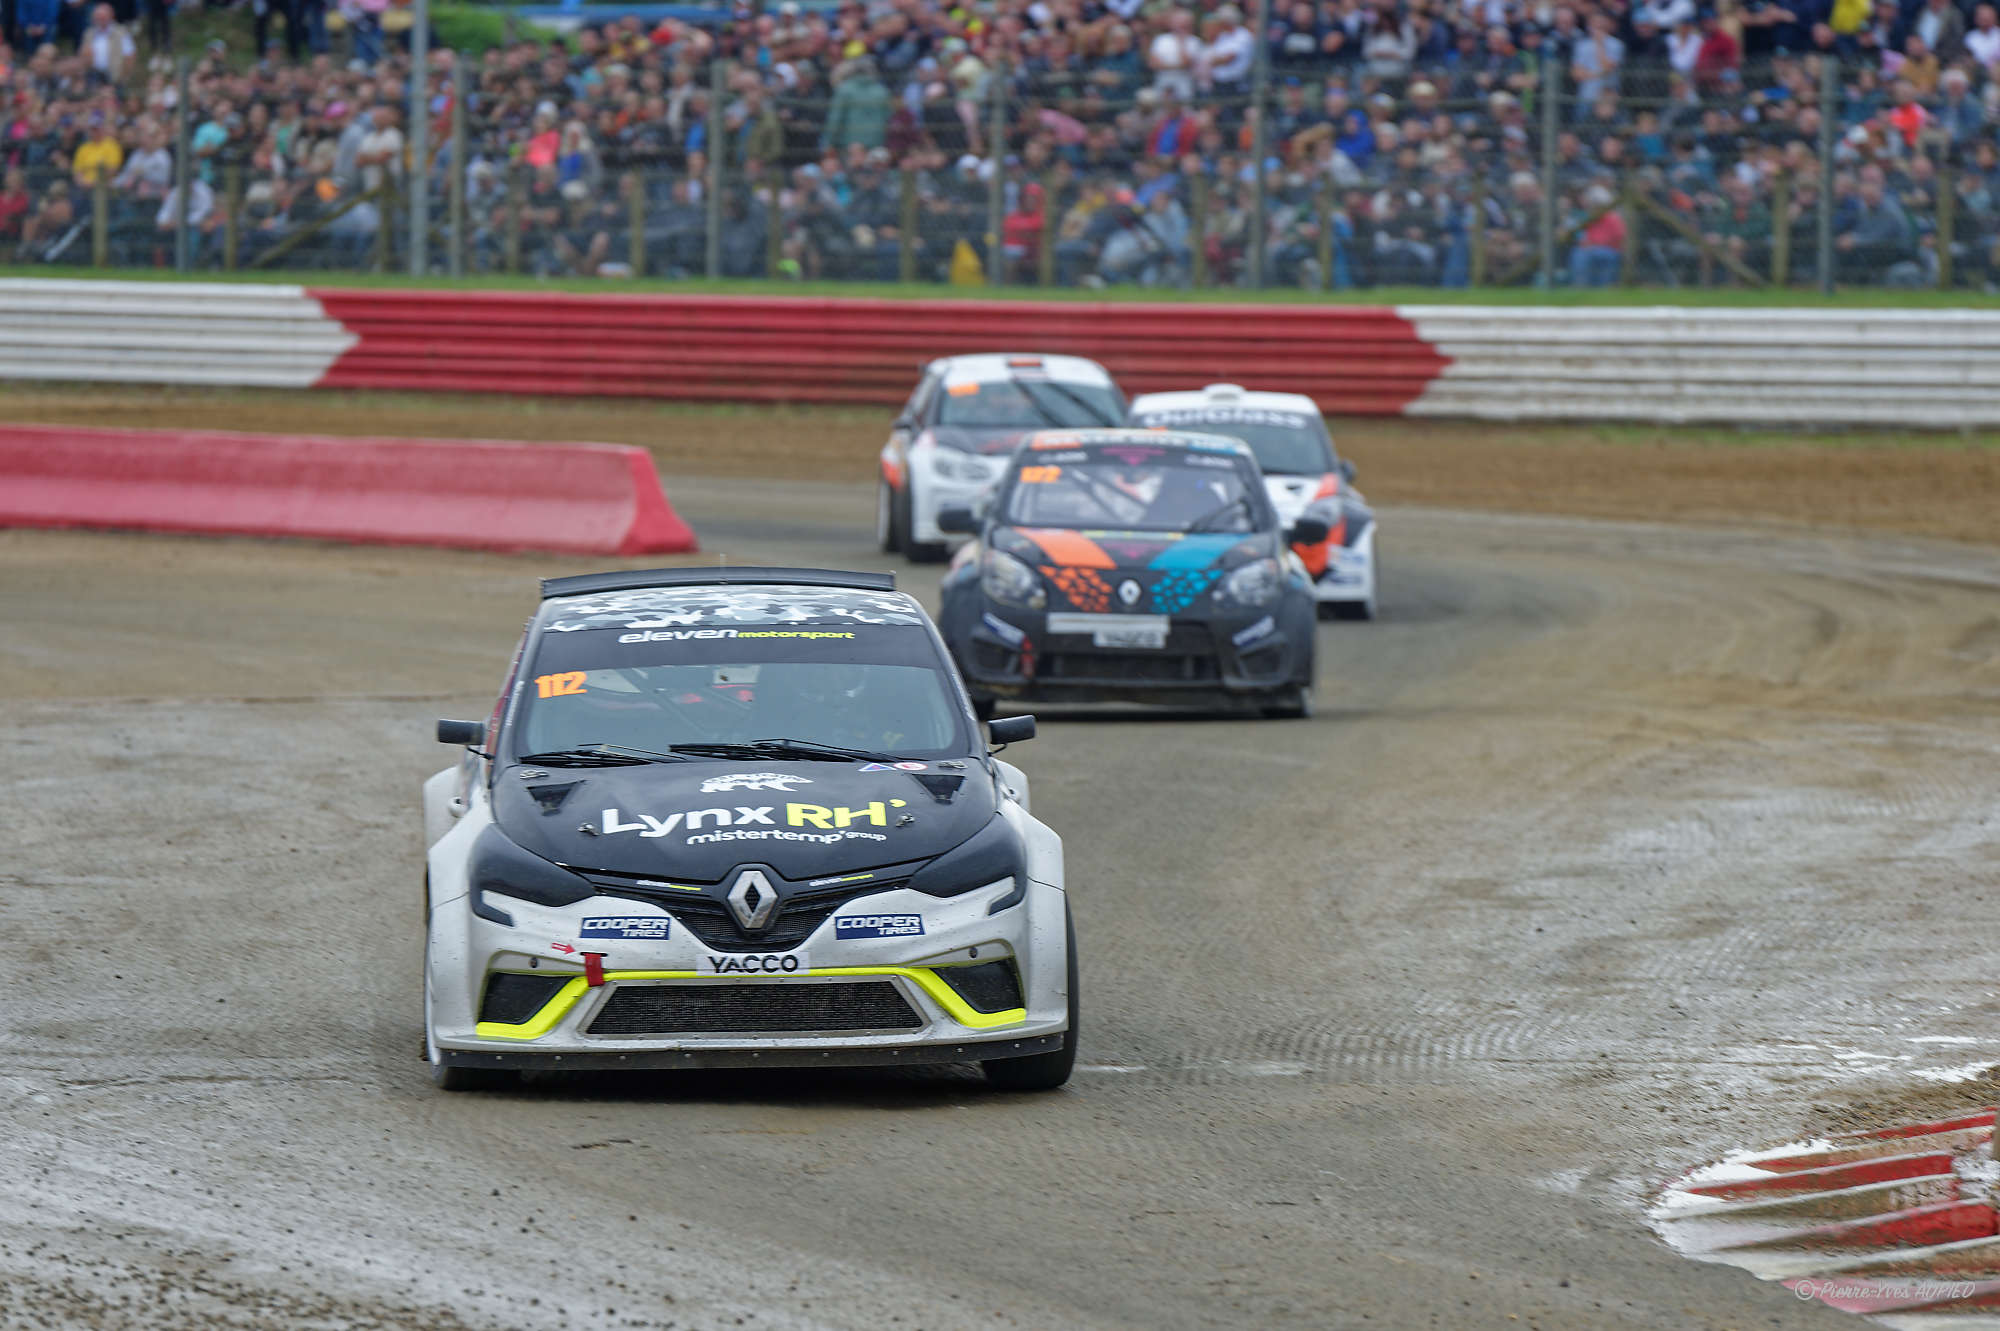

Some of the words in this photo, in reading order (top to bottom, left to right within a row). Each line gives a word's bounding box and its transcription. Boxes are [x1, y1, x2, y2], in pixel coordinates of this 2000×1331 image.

[534, 671, 587, 698] 112
[602, 806, 774, 837] Lynx
[582, 918, 668, 931] COOPER
[837, 914, 919, 928] COOPER
[621, 928, 666, 938] TIRES
[878, 925, 921, 935] TIRES
[707, 954, 799, 974] YACCO
